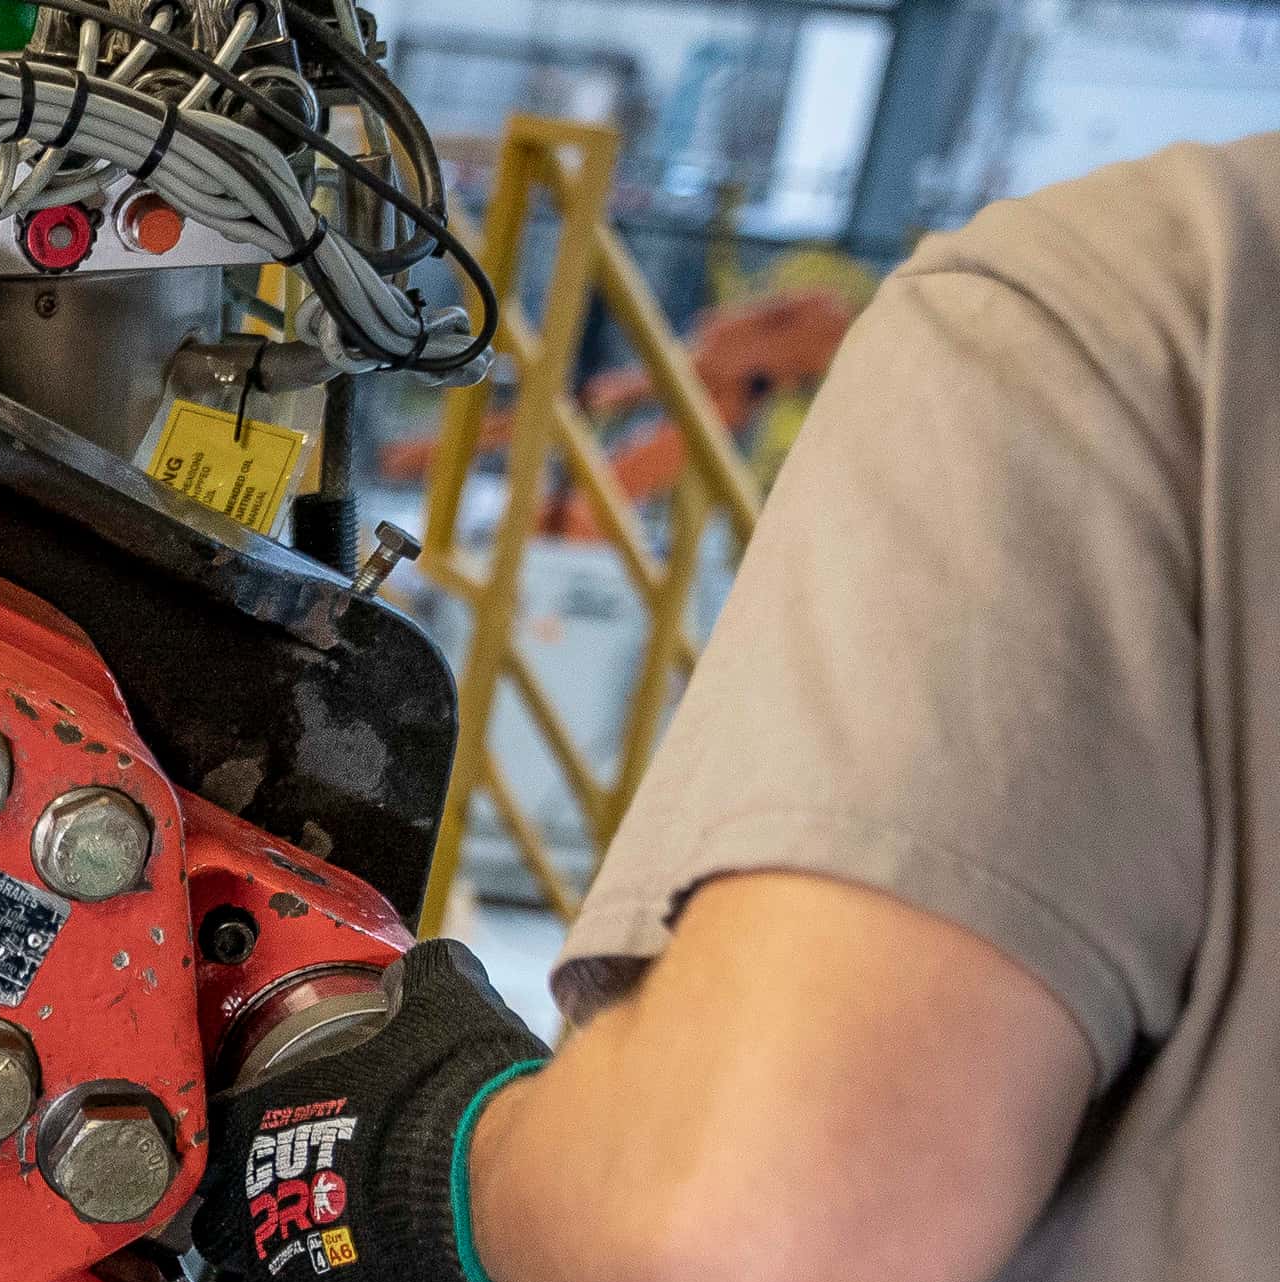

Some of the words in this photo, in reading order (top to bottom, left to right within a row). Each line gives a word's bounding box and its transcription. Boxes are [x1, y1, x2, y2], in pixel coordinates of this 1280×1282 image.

[245, 1117, 358, 1199] CUT
[250, 1170, 347, 1261] PRO
[329, 1244, 353, 1266] A6
